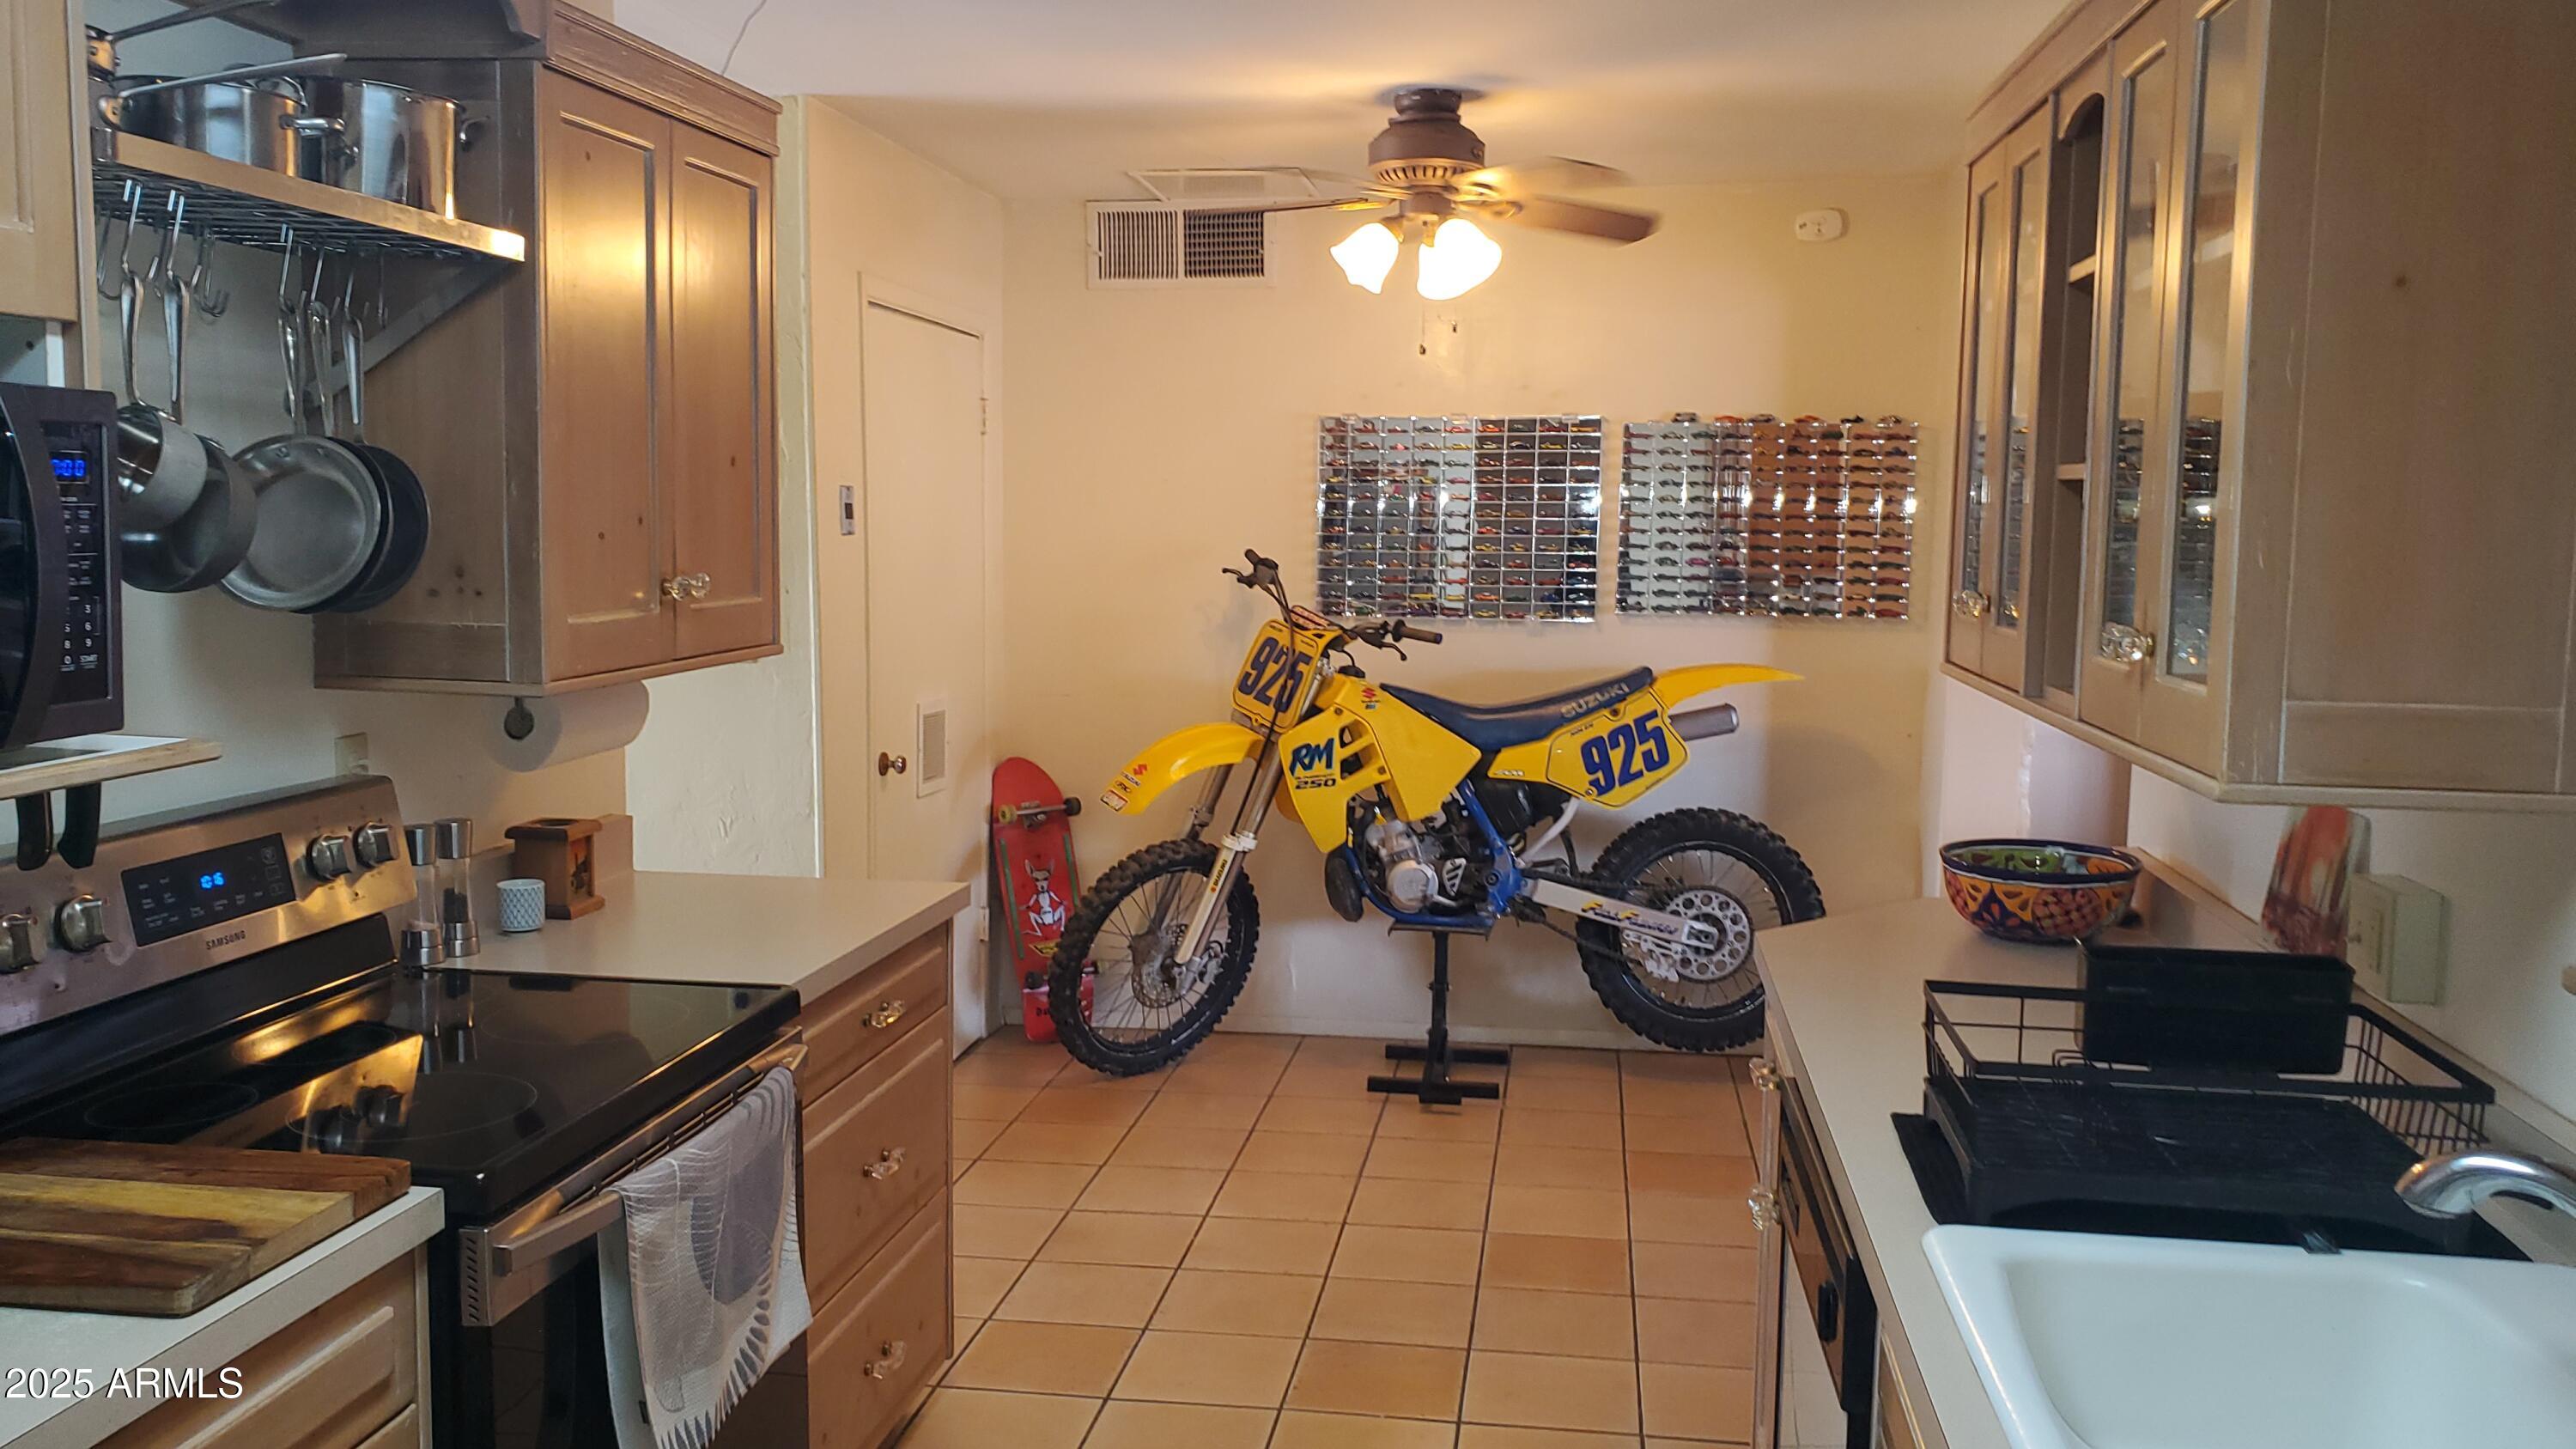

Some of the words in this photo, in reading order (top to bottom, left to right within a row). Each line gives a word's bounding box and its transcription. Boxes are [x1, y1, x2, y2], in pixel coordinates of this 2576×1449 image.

[84, 621, 92, 631] 6
[85, 637, 93, 648] 9
[1237, 636, 1314, 714] 925
[1559, 681, 1631, 719] SUZUKI
[1289, 737, 1335, 777] RM
[1580, 709, 1671, 797] 925
[1295, 777, 1337, 789] 250
[205, 929, 246, 951] SAMSUNG
